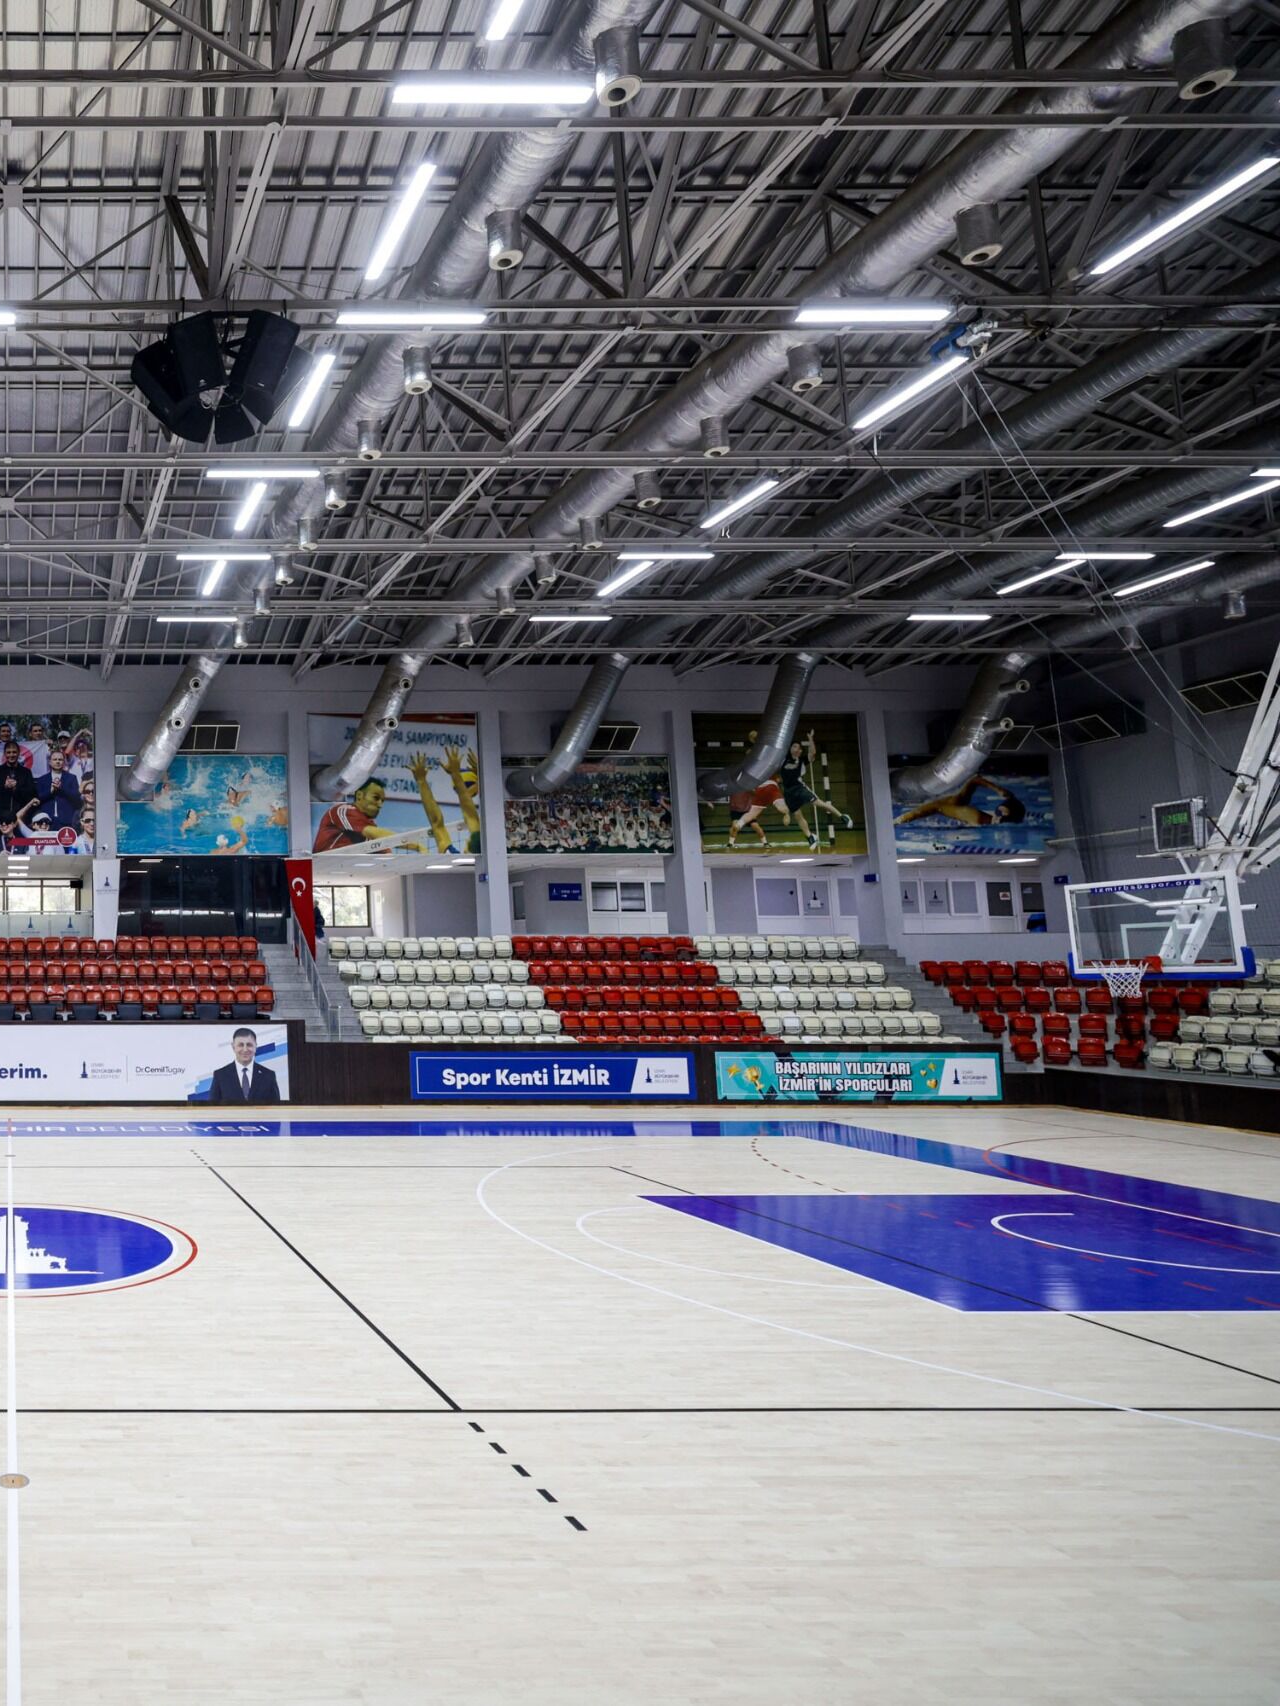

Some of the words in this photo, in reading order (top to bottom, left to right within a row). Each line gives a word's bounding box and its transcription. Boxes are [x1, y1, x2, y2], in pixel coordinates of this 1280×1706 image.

[442, 1068, 491, 1089] Spor
[495, 1067, 549, 1086] Kenti
[553, 1064, 610, 1086] İZMİR
[775, 1061, 841, 1077] BAŞARININ
[845, 1062, 911, 1075] YILDIZLARI
[835, 1078, 913, 1092] SPORCULARI
